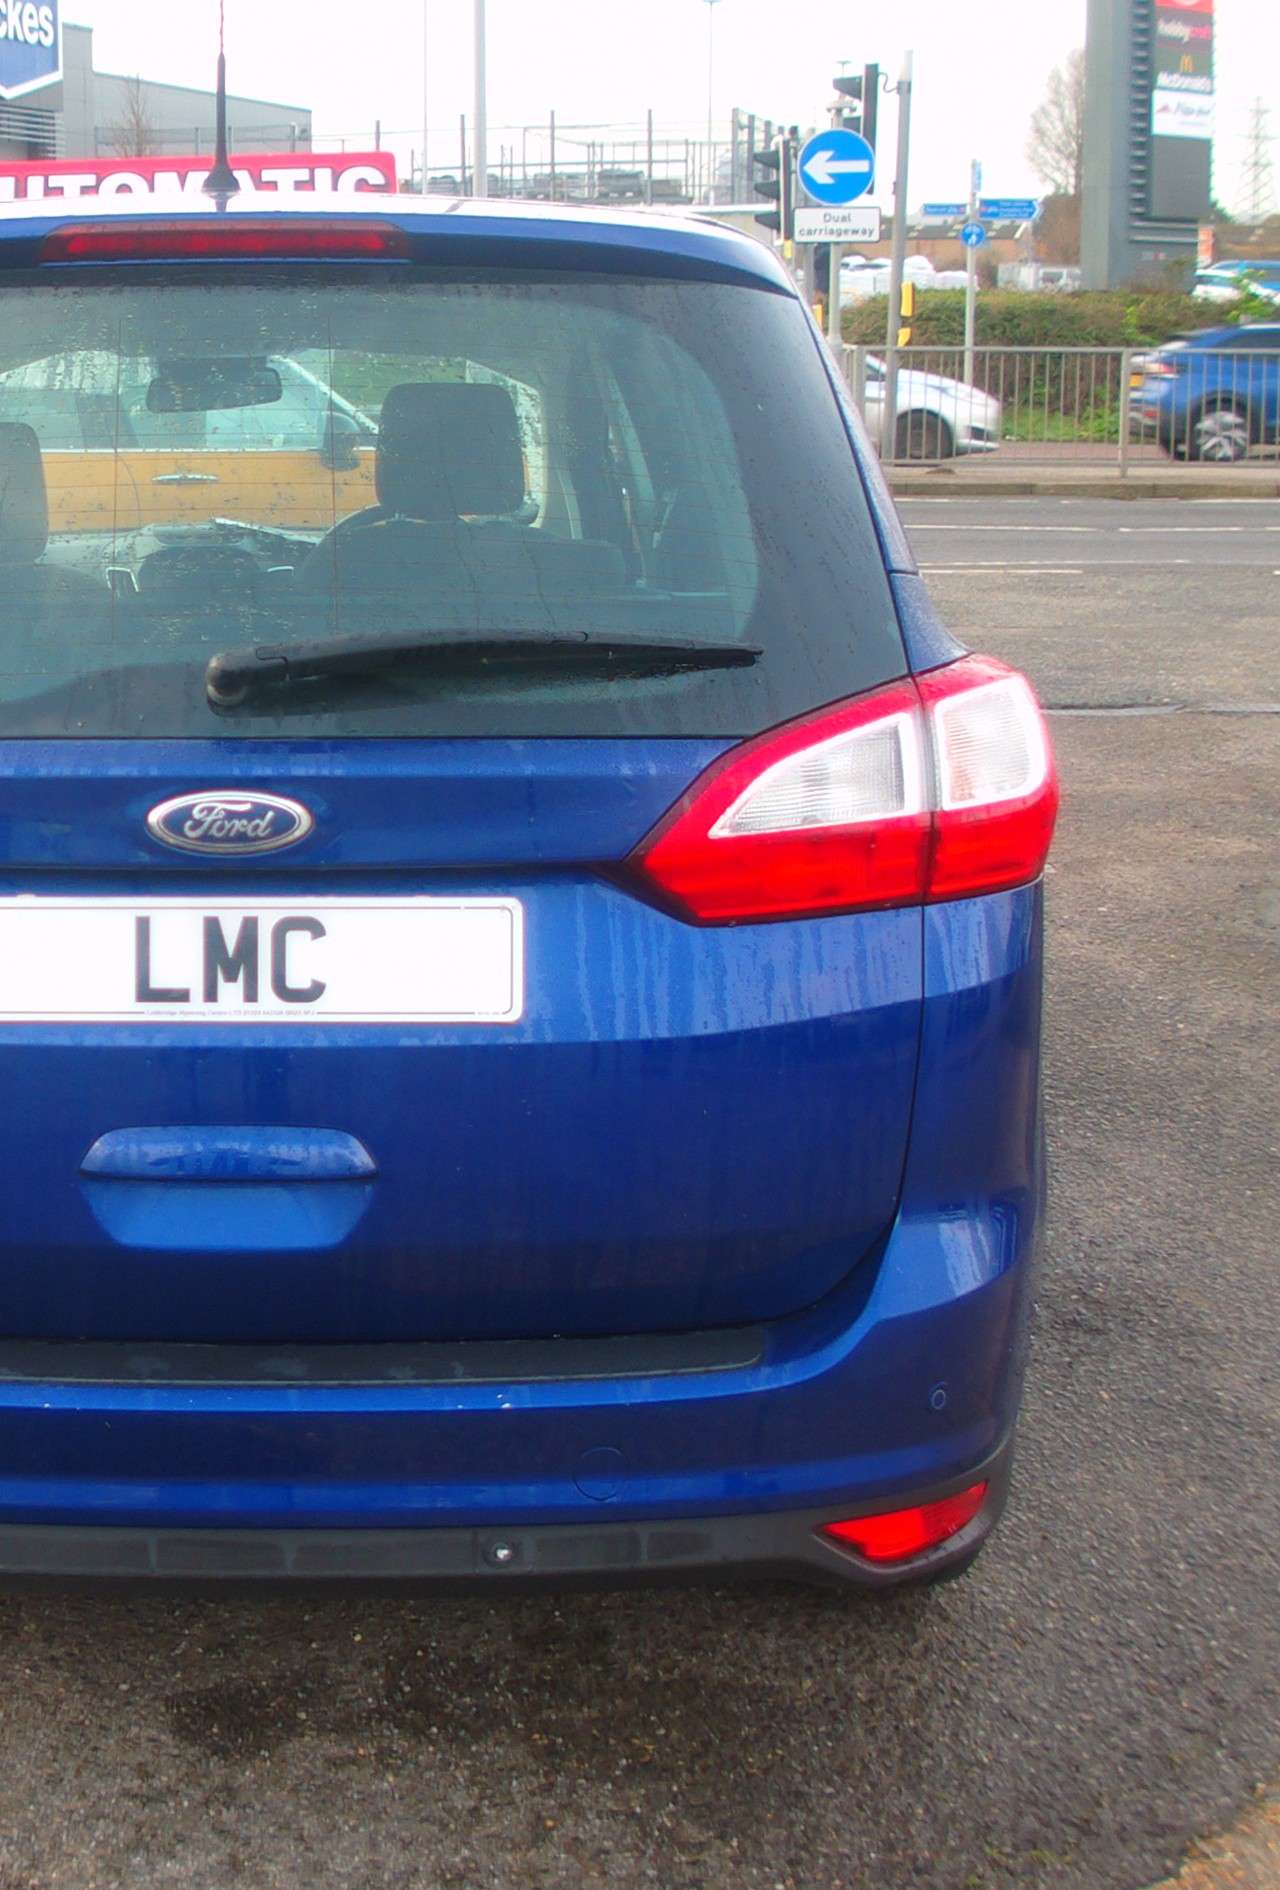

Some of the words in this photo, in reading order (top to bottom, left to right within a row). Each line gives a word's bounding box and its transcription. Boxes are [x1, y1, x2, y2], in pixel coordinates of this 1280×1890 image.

[823, 212, 851, 223] Dual
[799, 225, 875, 237] carriageway
[183, 802, 275, 838] Ford
[135, 915, 327, 1003] LMC
